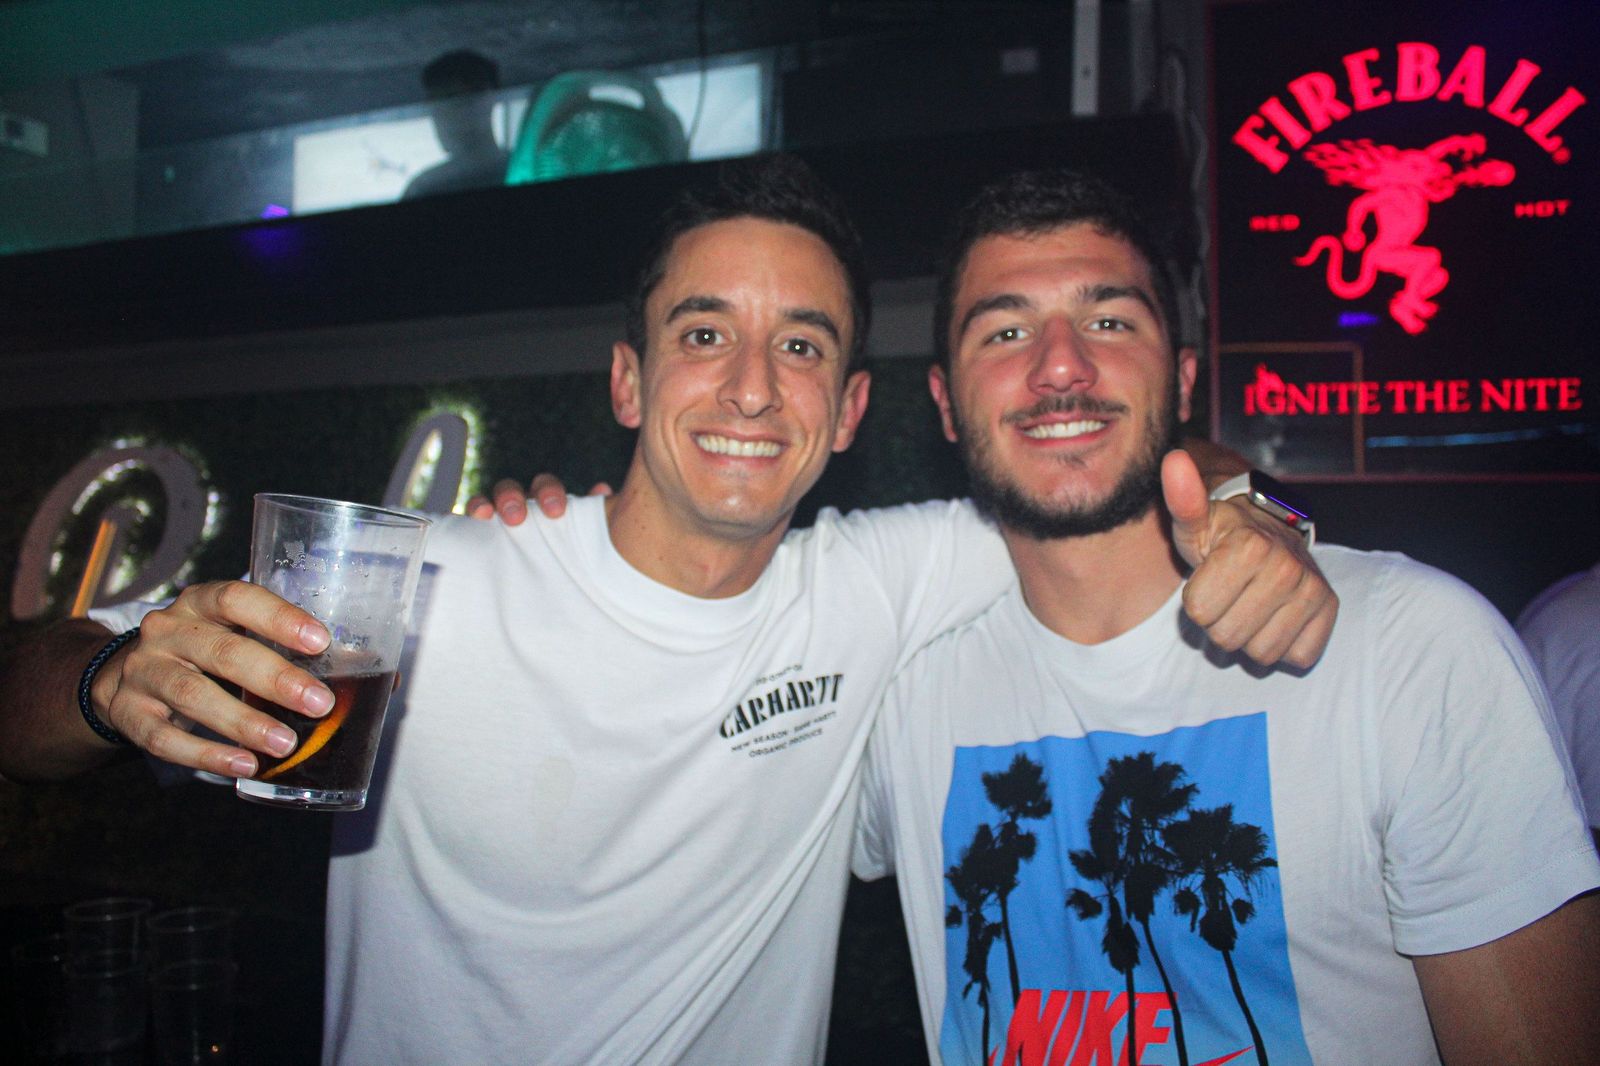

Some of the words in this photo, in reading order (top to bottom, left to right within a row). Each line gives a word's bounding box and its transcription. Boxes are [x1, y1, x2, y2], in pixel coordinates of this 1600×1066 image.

[1233, 41, 1587, 174] FIREBALL
[1244, 378, 1381, 416] IGNITE
[1385, 381, 1471, 414] THE
[1480, 378, 1583, 413] NITE
[719, 673, 844, 739] CARHARTT
[1002, 989, 1177, 1066] NIKE
